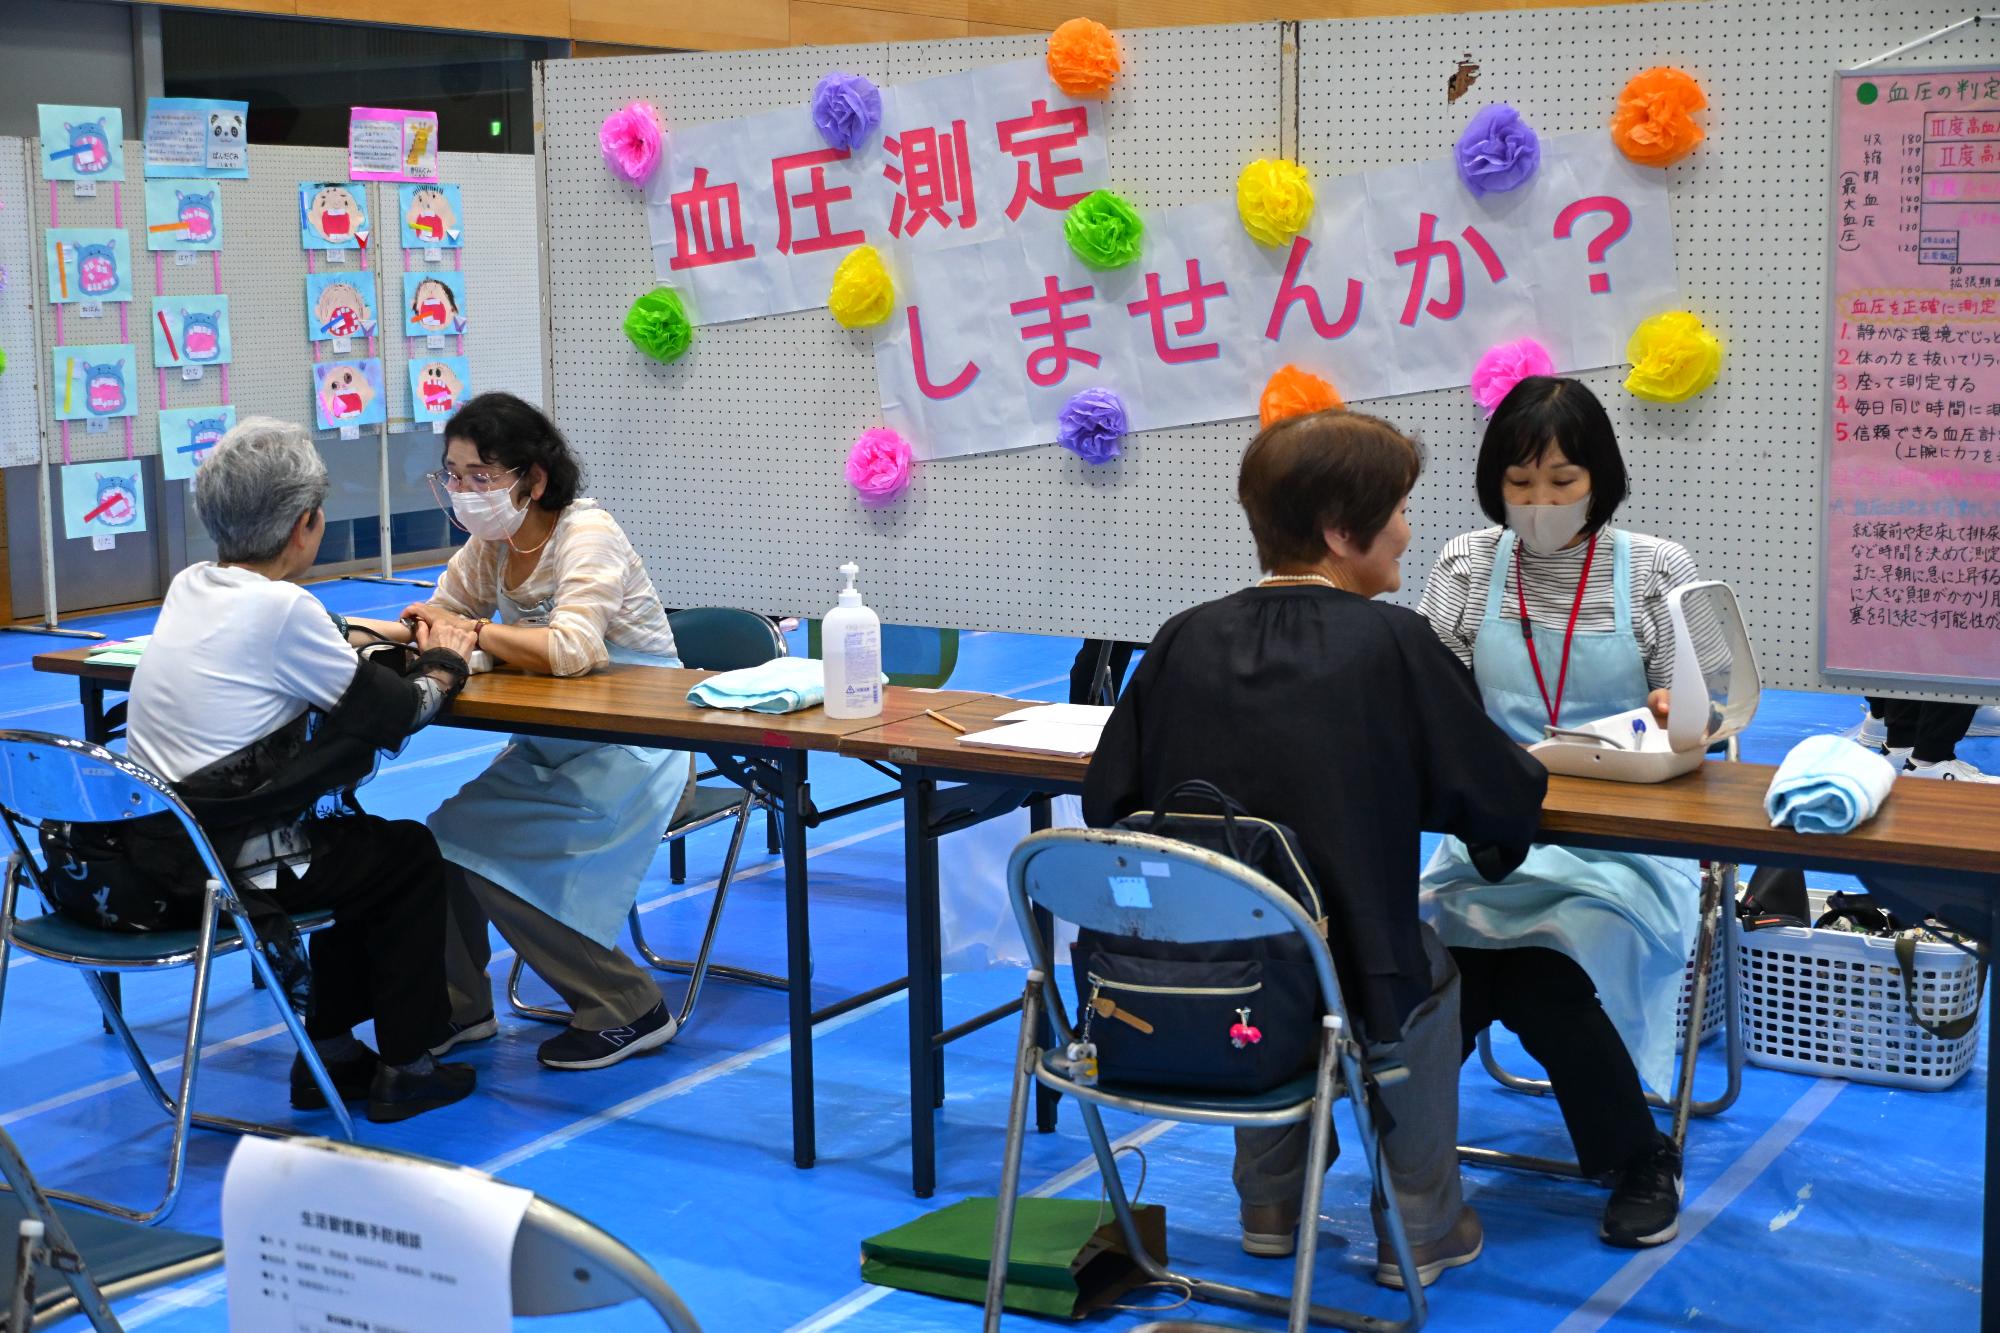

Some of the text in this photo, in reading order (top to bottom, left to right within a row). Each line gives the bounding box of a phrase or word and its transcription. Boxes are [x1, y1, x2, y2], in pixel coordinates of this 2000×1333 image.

[1887, 76, 2000, 103] 血圧の判定
[1901, 134, 1922, 146] 180
[670, 99, 1095, 271] 血圧測定
[1862, 134, 1882, 228] 収縮期血圧
[1898, 244, 1918, 253] 120
[906, 195, 1632, 399] しませんか？
[1851, 297, 1996, 316] 血圧を正確に測定
[1856, 350, 2000, 367] 体の力を抜いてリラ
[1855, 371, 1976, 393] 座って測定する
[1852, 424, 2000, 443] 信頼できる血圧計
